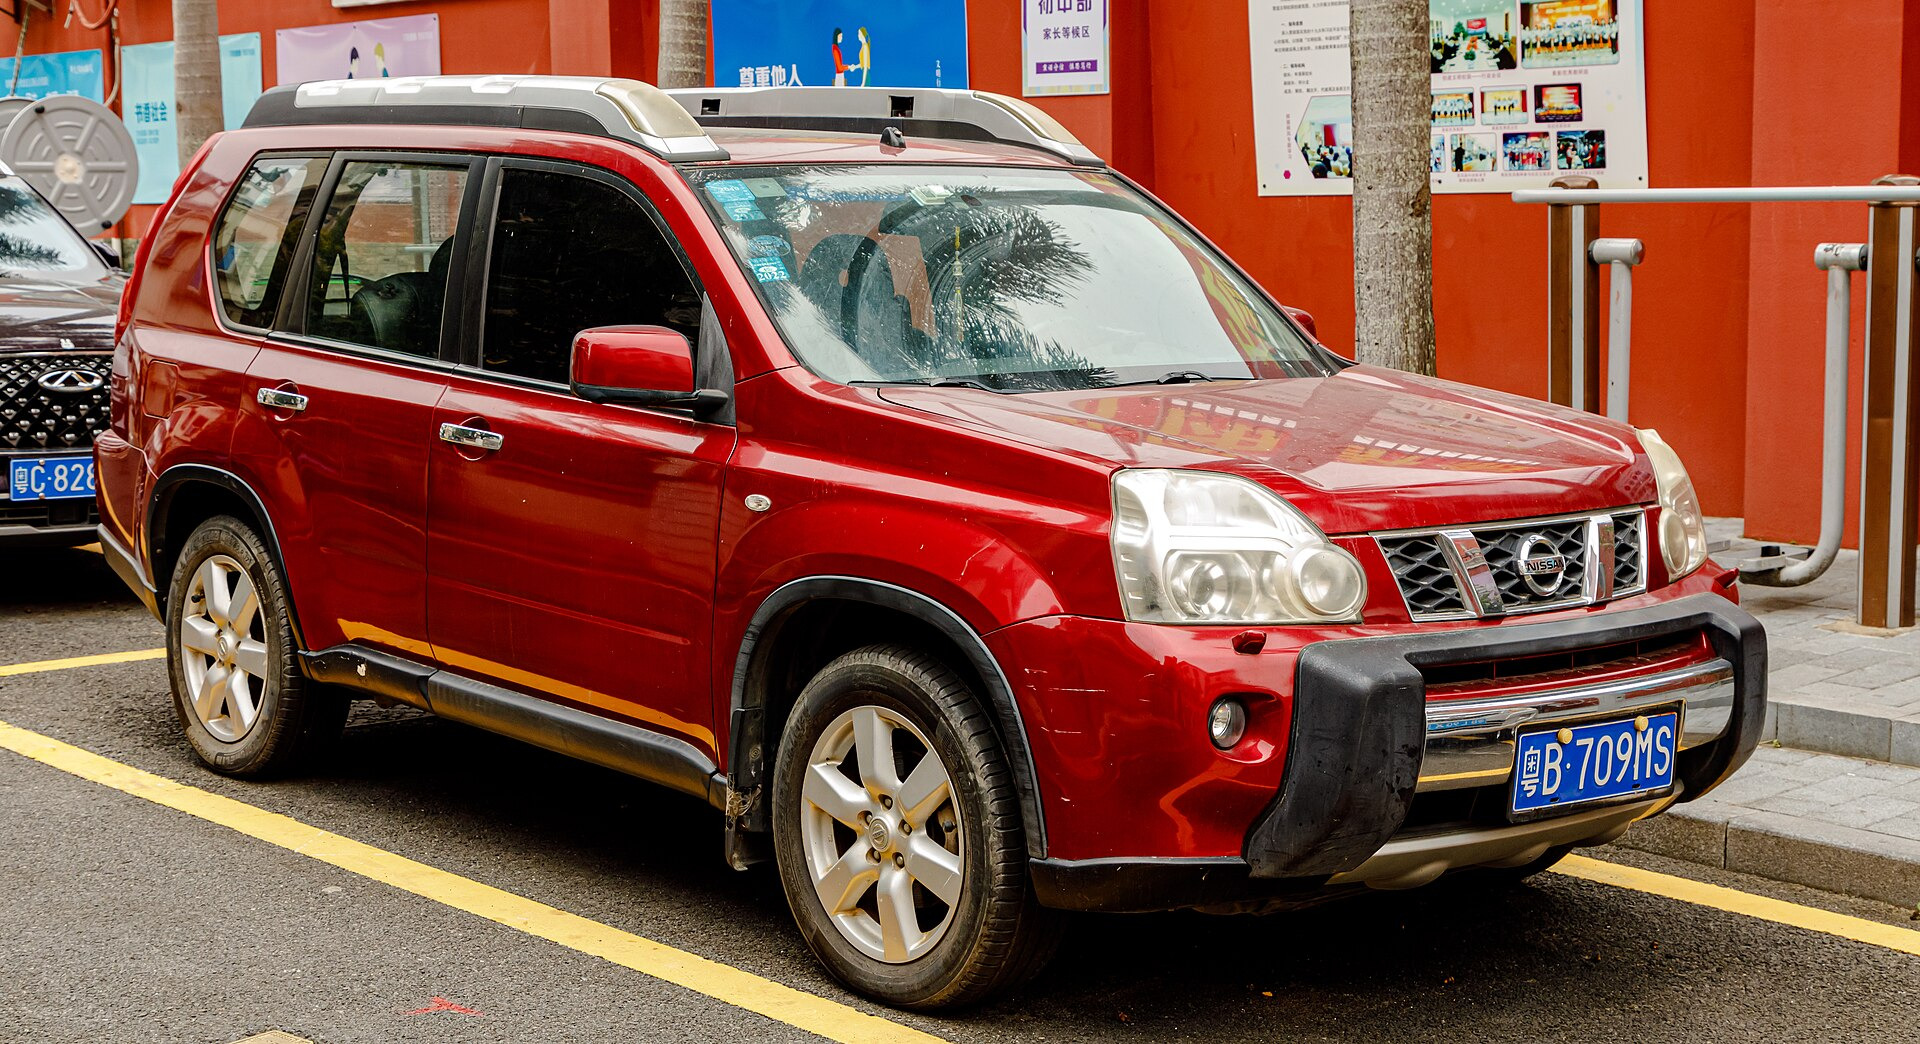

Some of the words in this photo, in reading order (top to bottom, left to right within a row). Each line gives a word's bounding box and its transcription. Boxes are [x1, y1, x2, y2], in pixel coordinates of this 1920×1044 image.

[1043, 26, 1090, 40] 家长等候区
[739, 64, 804, 87] 尊重他人
[757, 270, 787, 281] 2022
[1527, 560, 1564, 571] NISSAN
[1520, 725, 1672, 798] 粤B·709MS
